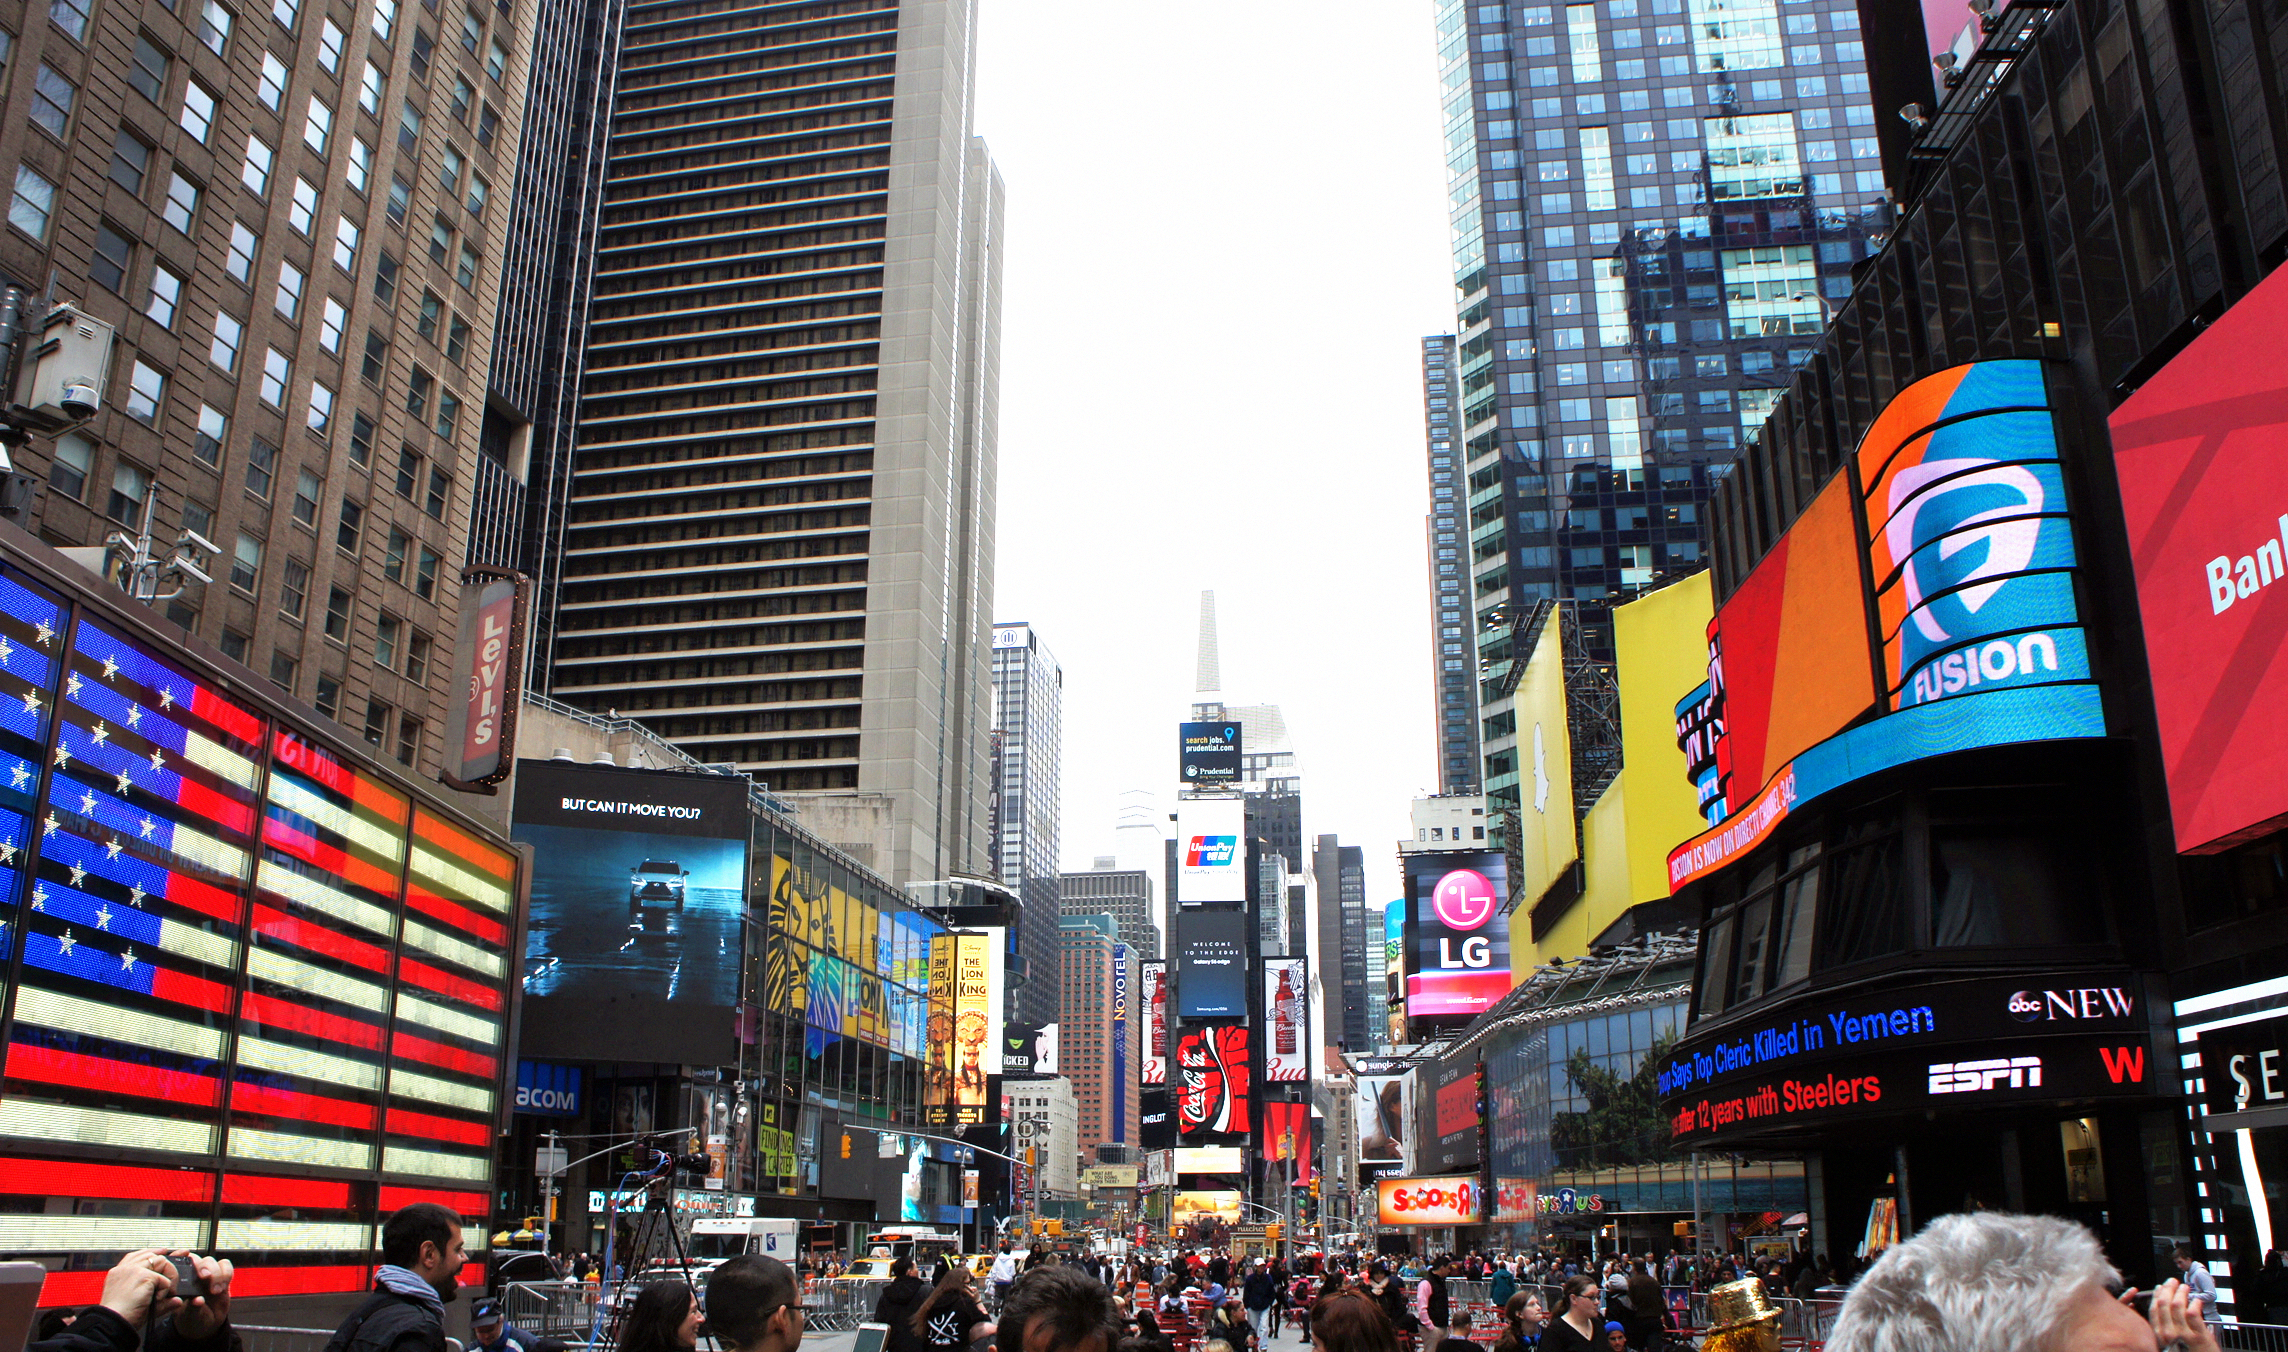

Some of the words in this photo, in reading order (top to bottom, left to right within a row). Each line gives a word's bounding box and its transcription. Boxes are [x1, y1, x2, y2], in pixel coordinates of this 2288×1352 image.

[1185, 744, 1234, 753] prudential.com
[1186, 736, 1208, 744] search
[1199, 767, 1234, 775] Prudential
[561, 797, 586, 811] BUT
[586, 800, 615, 813] CAN
[617, 802, 628, 814] IT
[629, 803, 666, 817] MOVE
[667, 806, 701, 820] YOU?
[1693, 845, 1704, 871] IS
[1703, 834, 1723, 866] NOW
[1722, 828, 1735, 857] ON
[964, 958, 980, 966] THE
[1439, 936, 1490, 969] LG
[961, 967, 984, 981] LION
[959, 981, 987, 998] KING
[1113, 952, 1126, 1021] NOVOTEL
[2008, 998, 2043, 1013] abc
[2042, 987, 2133, 1020] NEW
[1671, 1060, 1693, 1091] Says
[1693, 1051, 1713, 1084] Top
[1715, 1037, 1752, 1074] Cleric
[1754, 1021, 1799, 1063] Killed
[1803, 1019, 1824, 1051] in
[1827, 1005, 1935, 1046] Yemen
[1928, 1056, 2043, 1095] ESPN
[1678, 1106, 1696, 1134] after
[1697, 1099, 1710, 1129] 12
[1711, 1098, 1745, 1132] years
[1745, 1084, 1780, 1118] with
[1782, 1073, 1881, 1113] Steelers
[1142, 1112, 1166, 1125] INGLOT
